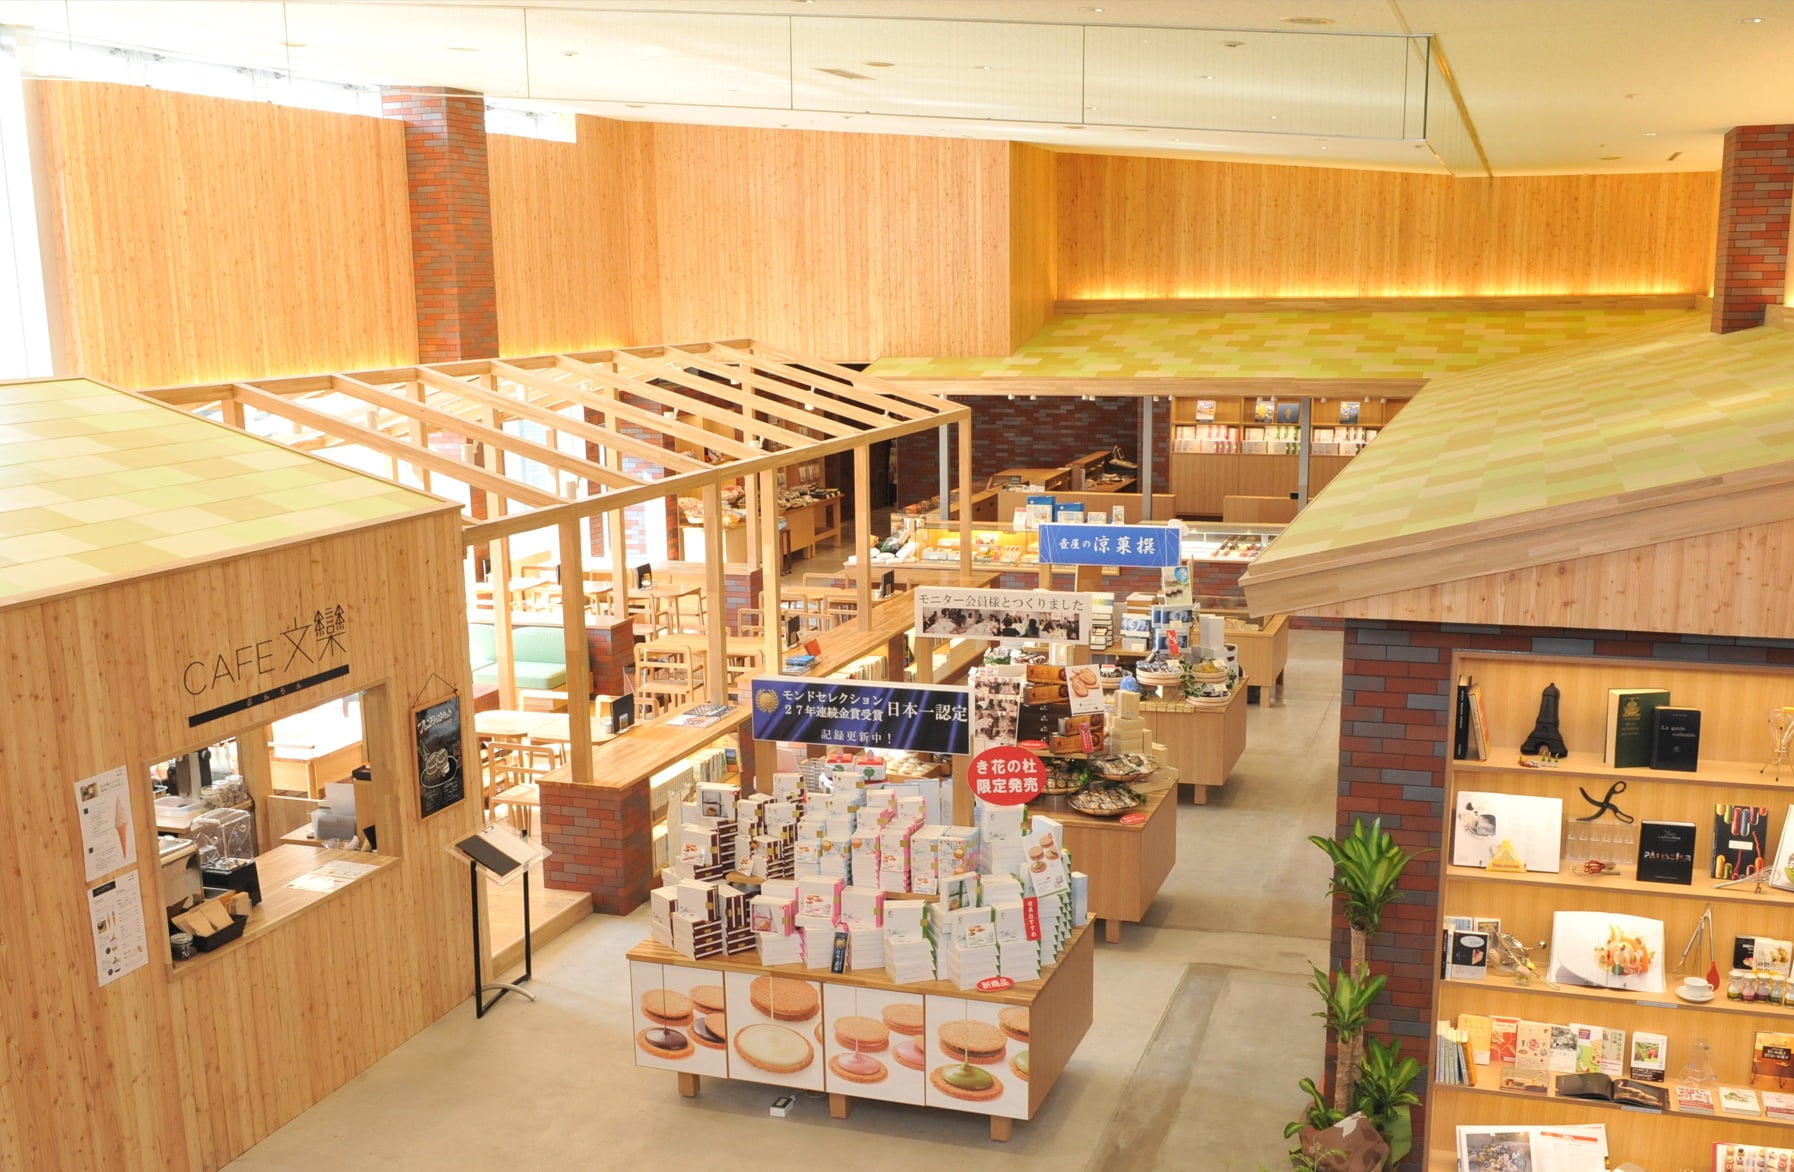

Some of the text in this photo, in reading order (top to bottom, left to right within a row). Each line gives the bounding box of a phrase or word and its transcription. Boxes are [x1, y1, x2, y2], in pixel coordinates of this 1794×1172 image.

[919, 594, 1084, 613] モニター会員様とつくりました
[183, 639, 276, 696] CAFE
[782, 689, 884, 705] モンドセレクション
[887, 701, 969, 722] 日本一認定
[820, 728, 892, 746] 記録更新中！
[976, 758, 1038, 775] き花の杜
[976, 777, 1039, 795] 限定発売
[981, 978, 1010, 990] 新商品
